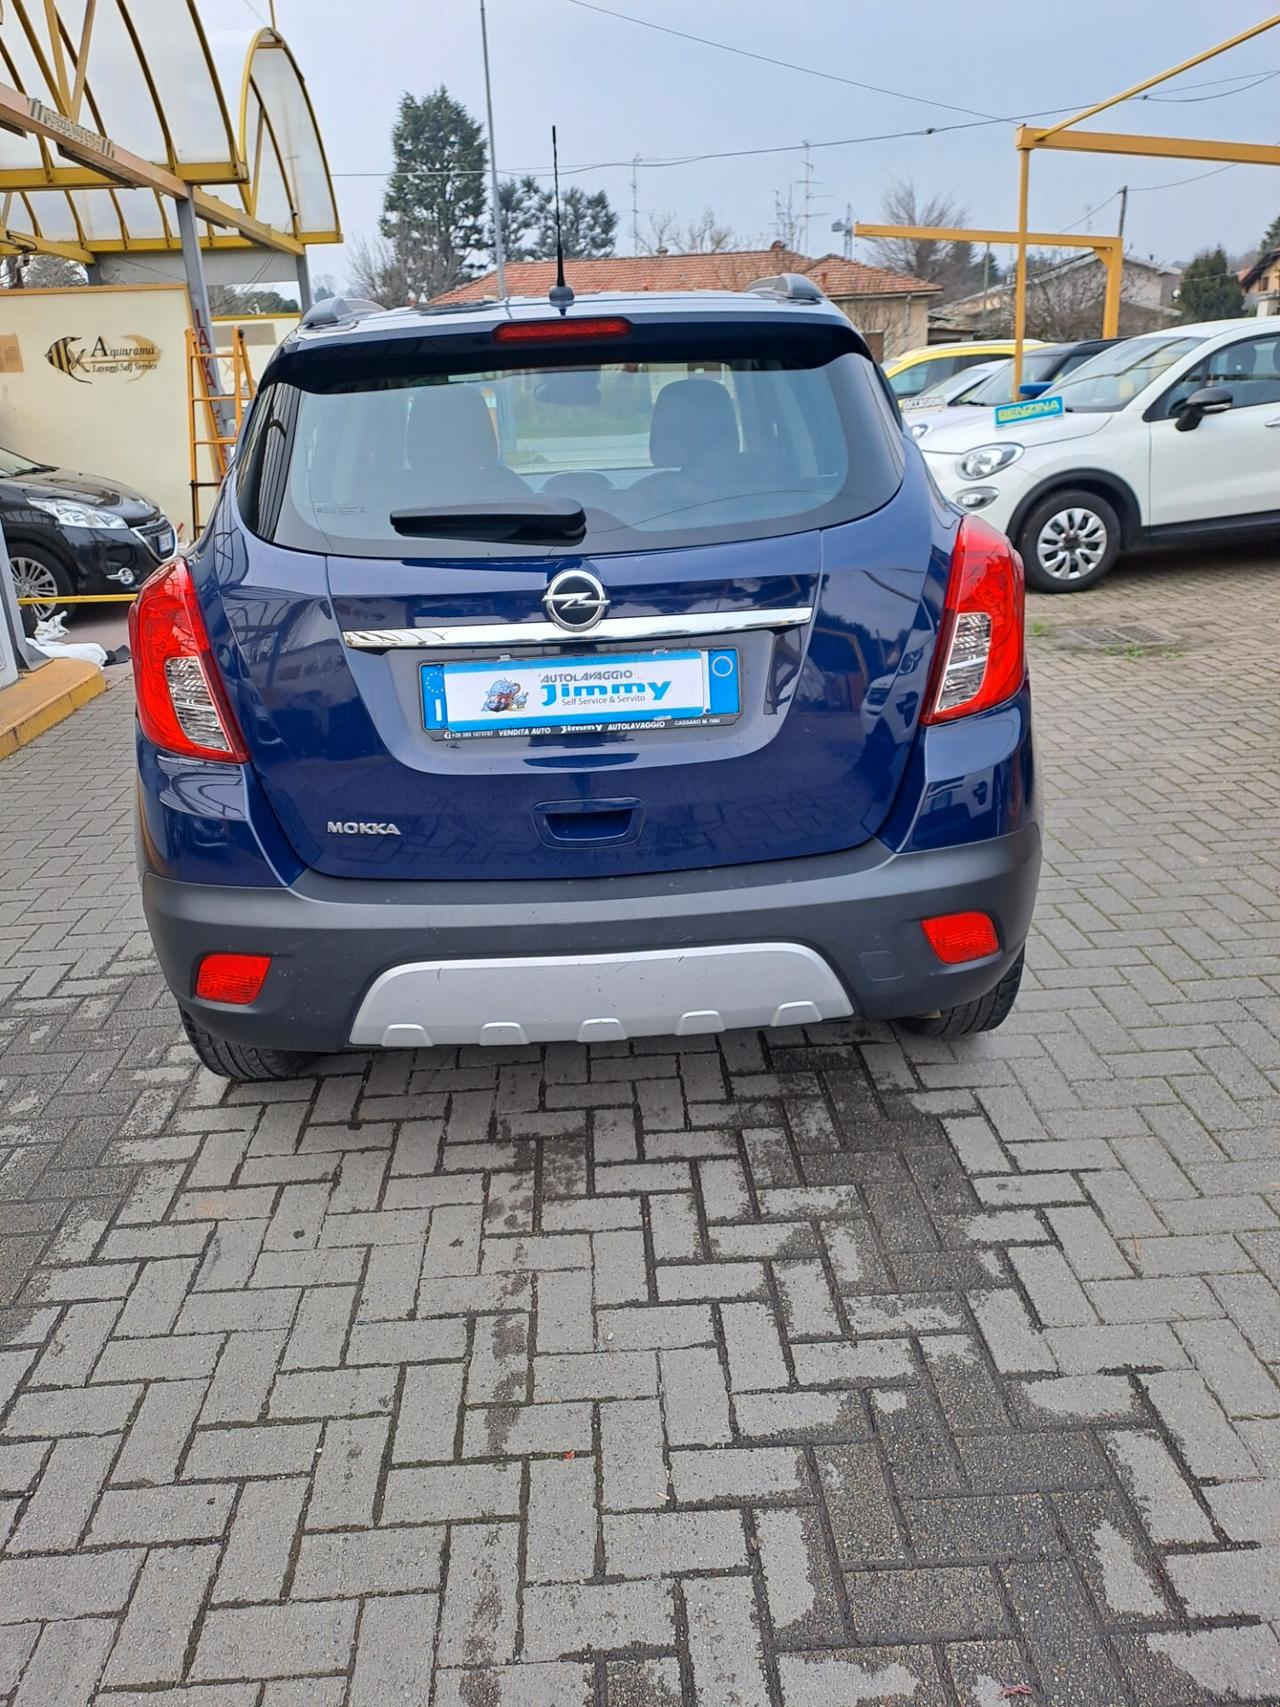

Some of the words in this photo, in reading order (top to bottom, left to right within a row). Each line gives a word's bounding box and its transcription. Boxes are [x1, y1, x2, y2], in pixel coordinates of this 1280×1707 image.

[998, 400, 1059, 421] BENZINA
[541, 670, 633, 683] AUTOLAVAGGIO
[541, 681, 672, 706] Jimmy
[562, 697, 576, 706] Self
[578, 696, 608, 705] Service
[617, 694, 646, 703] Servito
[498, 728, 530, 736] VENDITA
[531, 727, 551, 735] AUTO
[560, 723, 602, 734] Jimmy
[607, 721, 665, 731] AUTOLAVAGGIO
[327, 821, 402, 835] MOKKA
